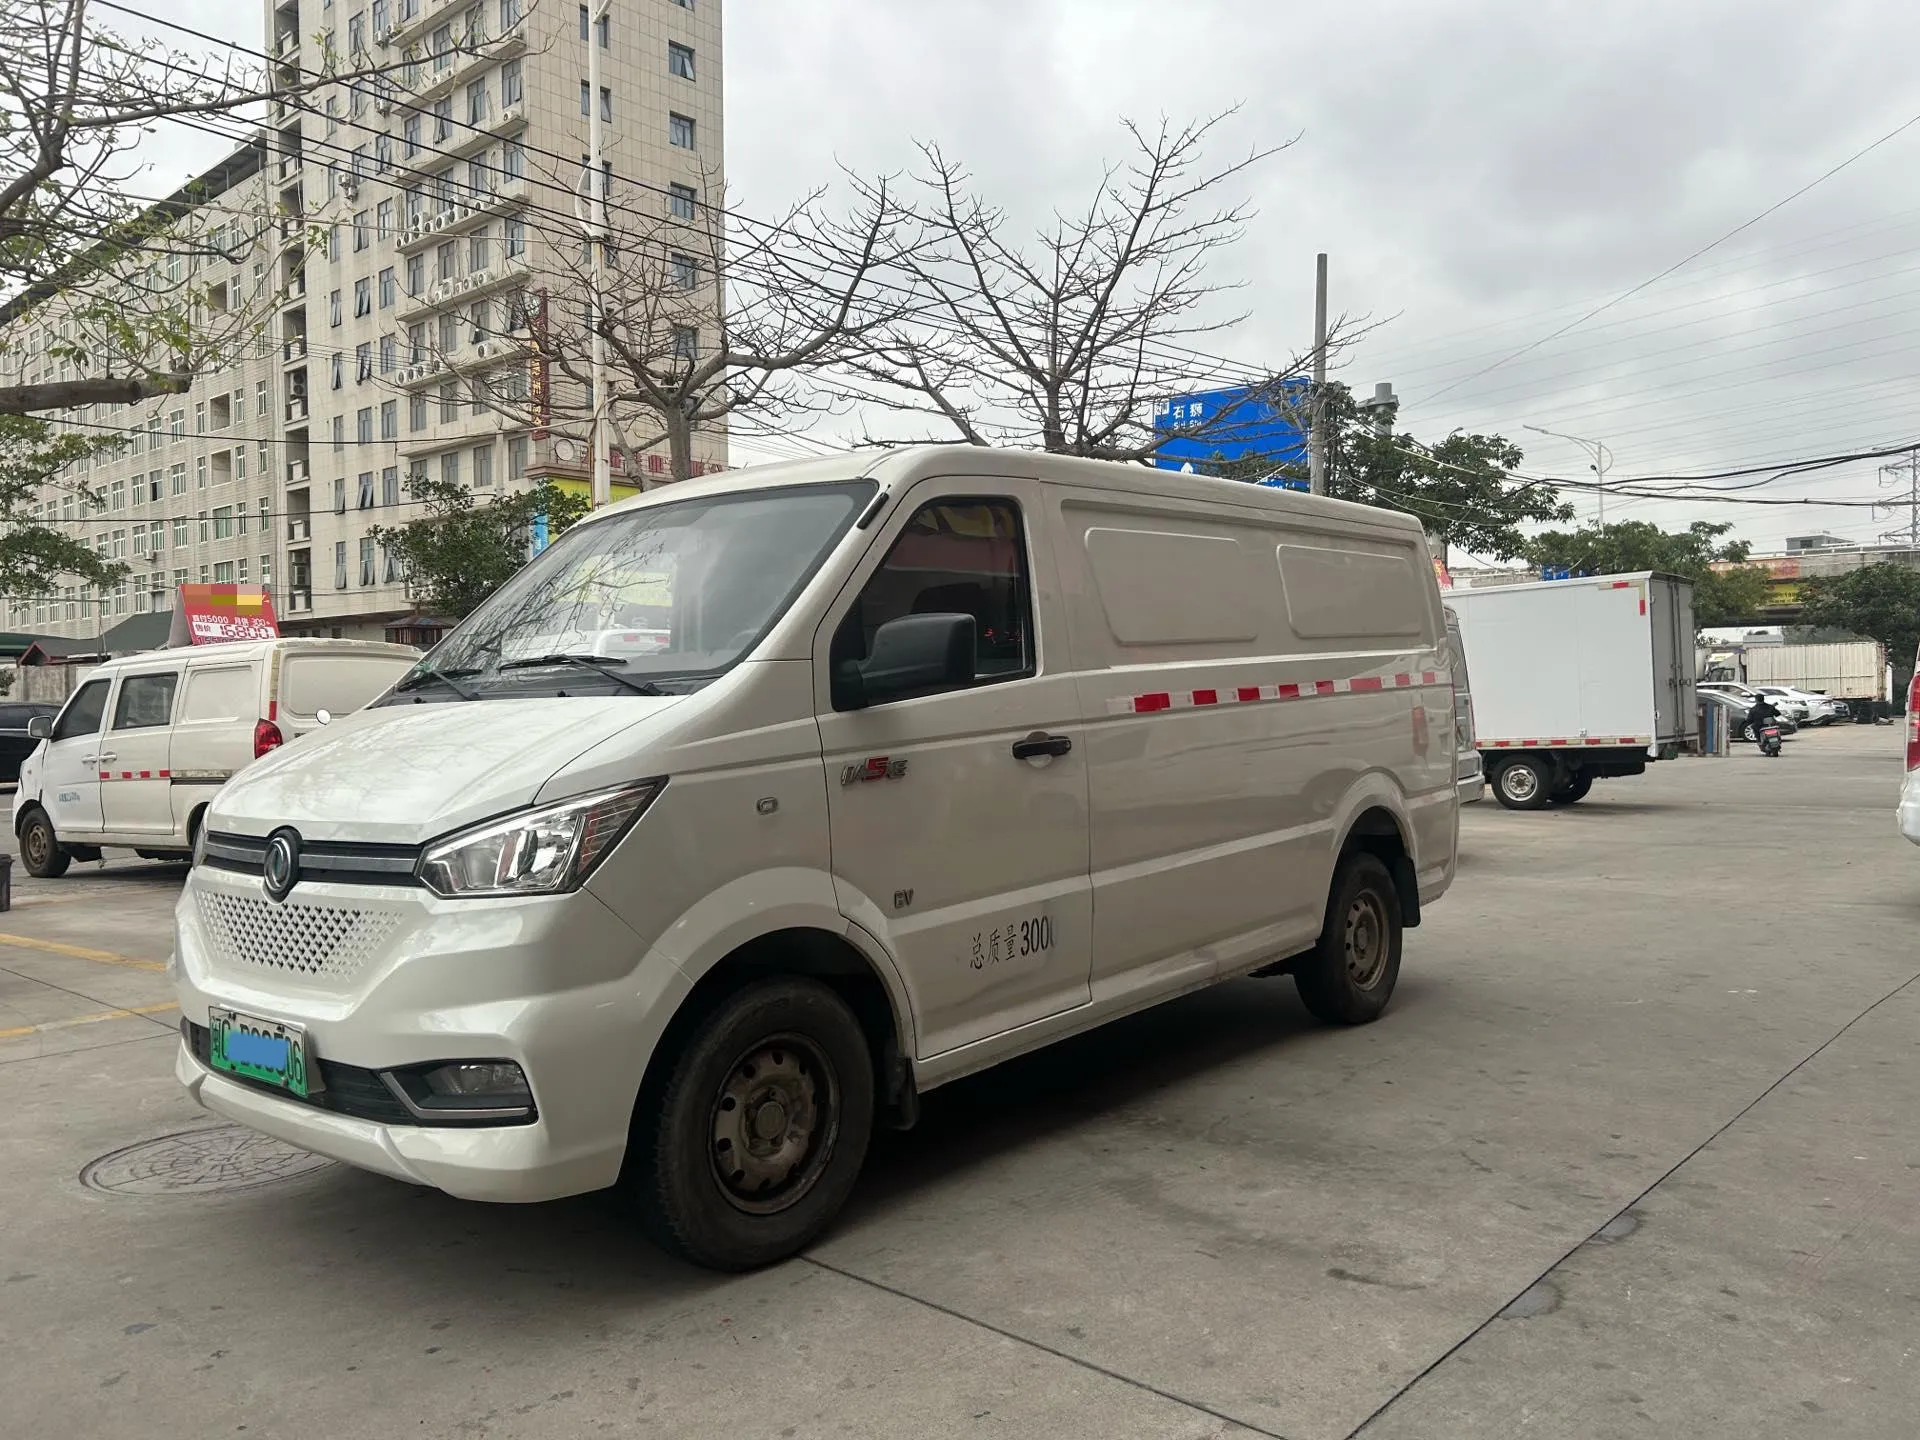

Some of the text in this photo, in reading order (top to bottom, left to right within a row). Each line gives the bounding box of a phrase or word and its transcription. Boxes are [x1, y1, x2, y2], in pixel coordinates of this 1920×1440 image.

[1173, 403, 1203, 420] 石狮
[220, 624, 270, 639] 16800
[894, 888, 914, 909] EV
